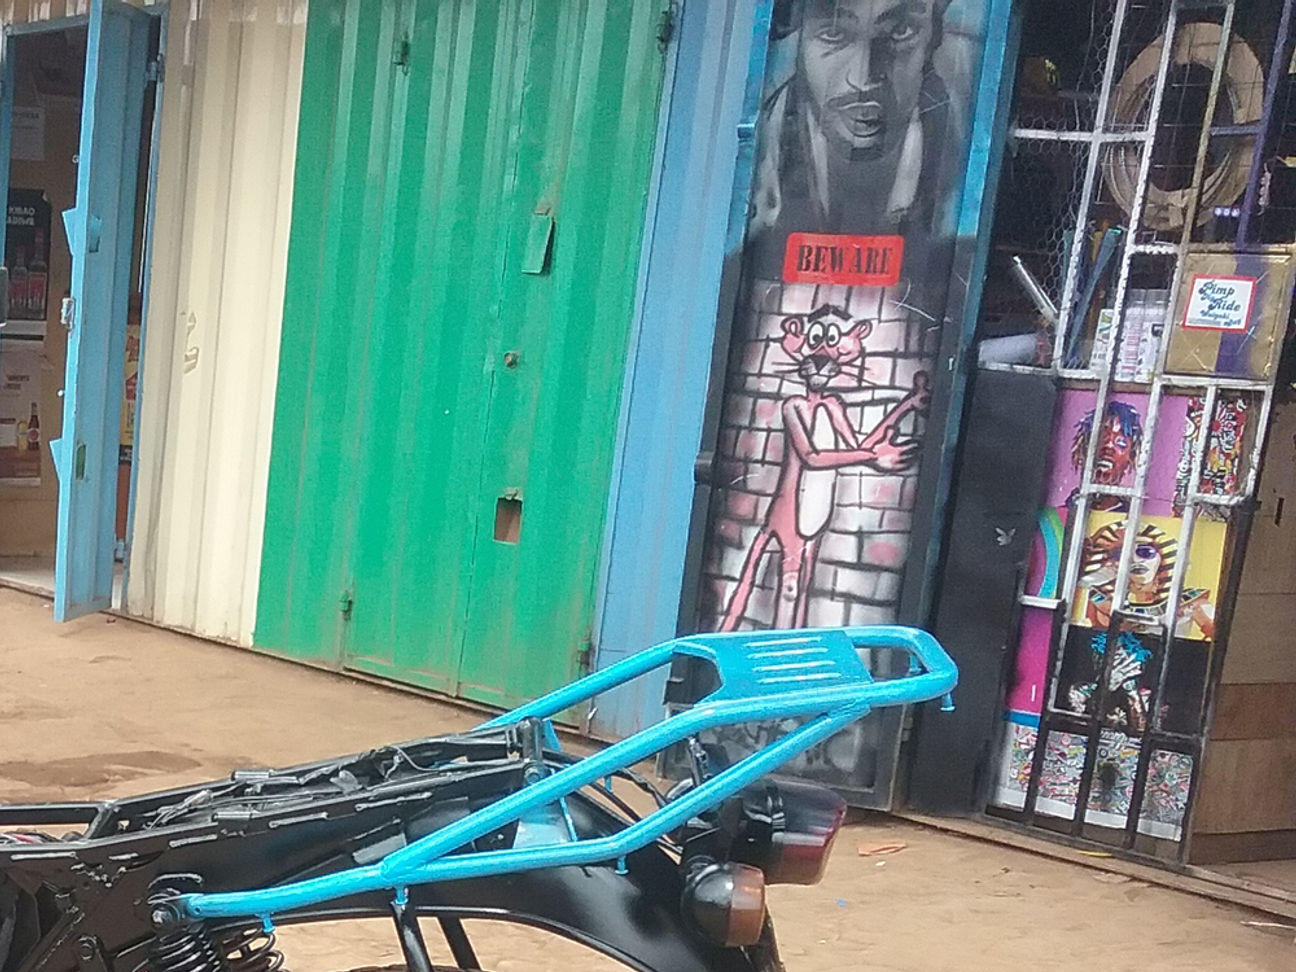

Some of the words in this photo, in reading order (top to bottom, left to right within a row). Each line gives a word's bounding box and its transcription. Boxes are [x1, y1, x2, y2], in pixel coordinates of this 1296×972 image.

[797, 245, 893, 274] BEWARE
[1198, 281, 1235, 298] Pimp
[1208, 298, 1241, 311] Ride
